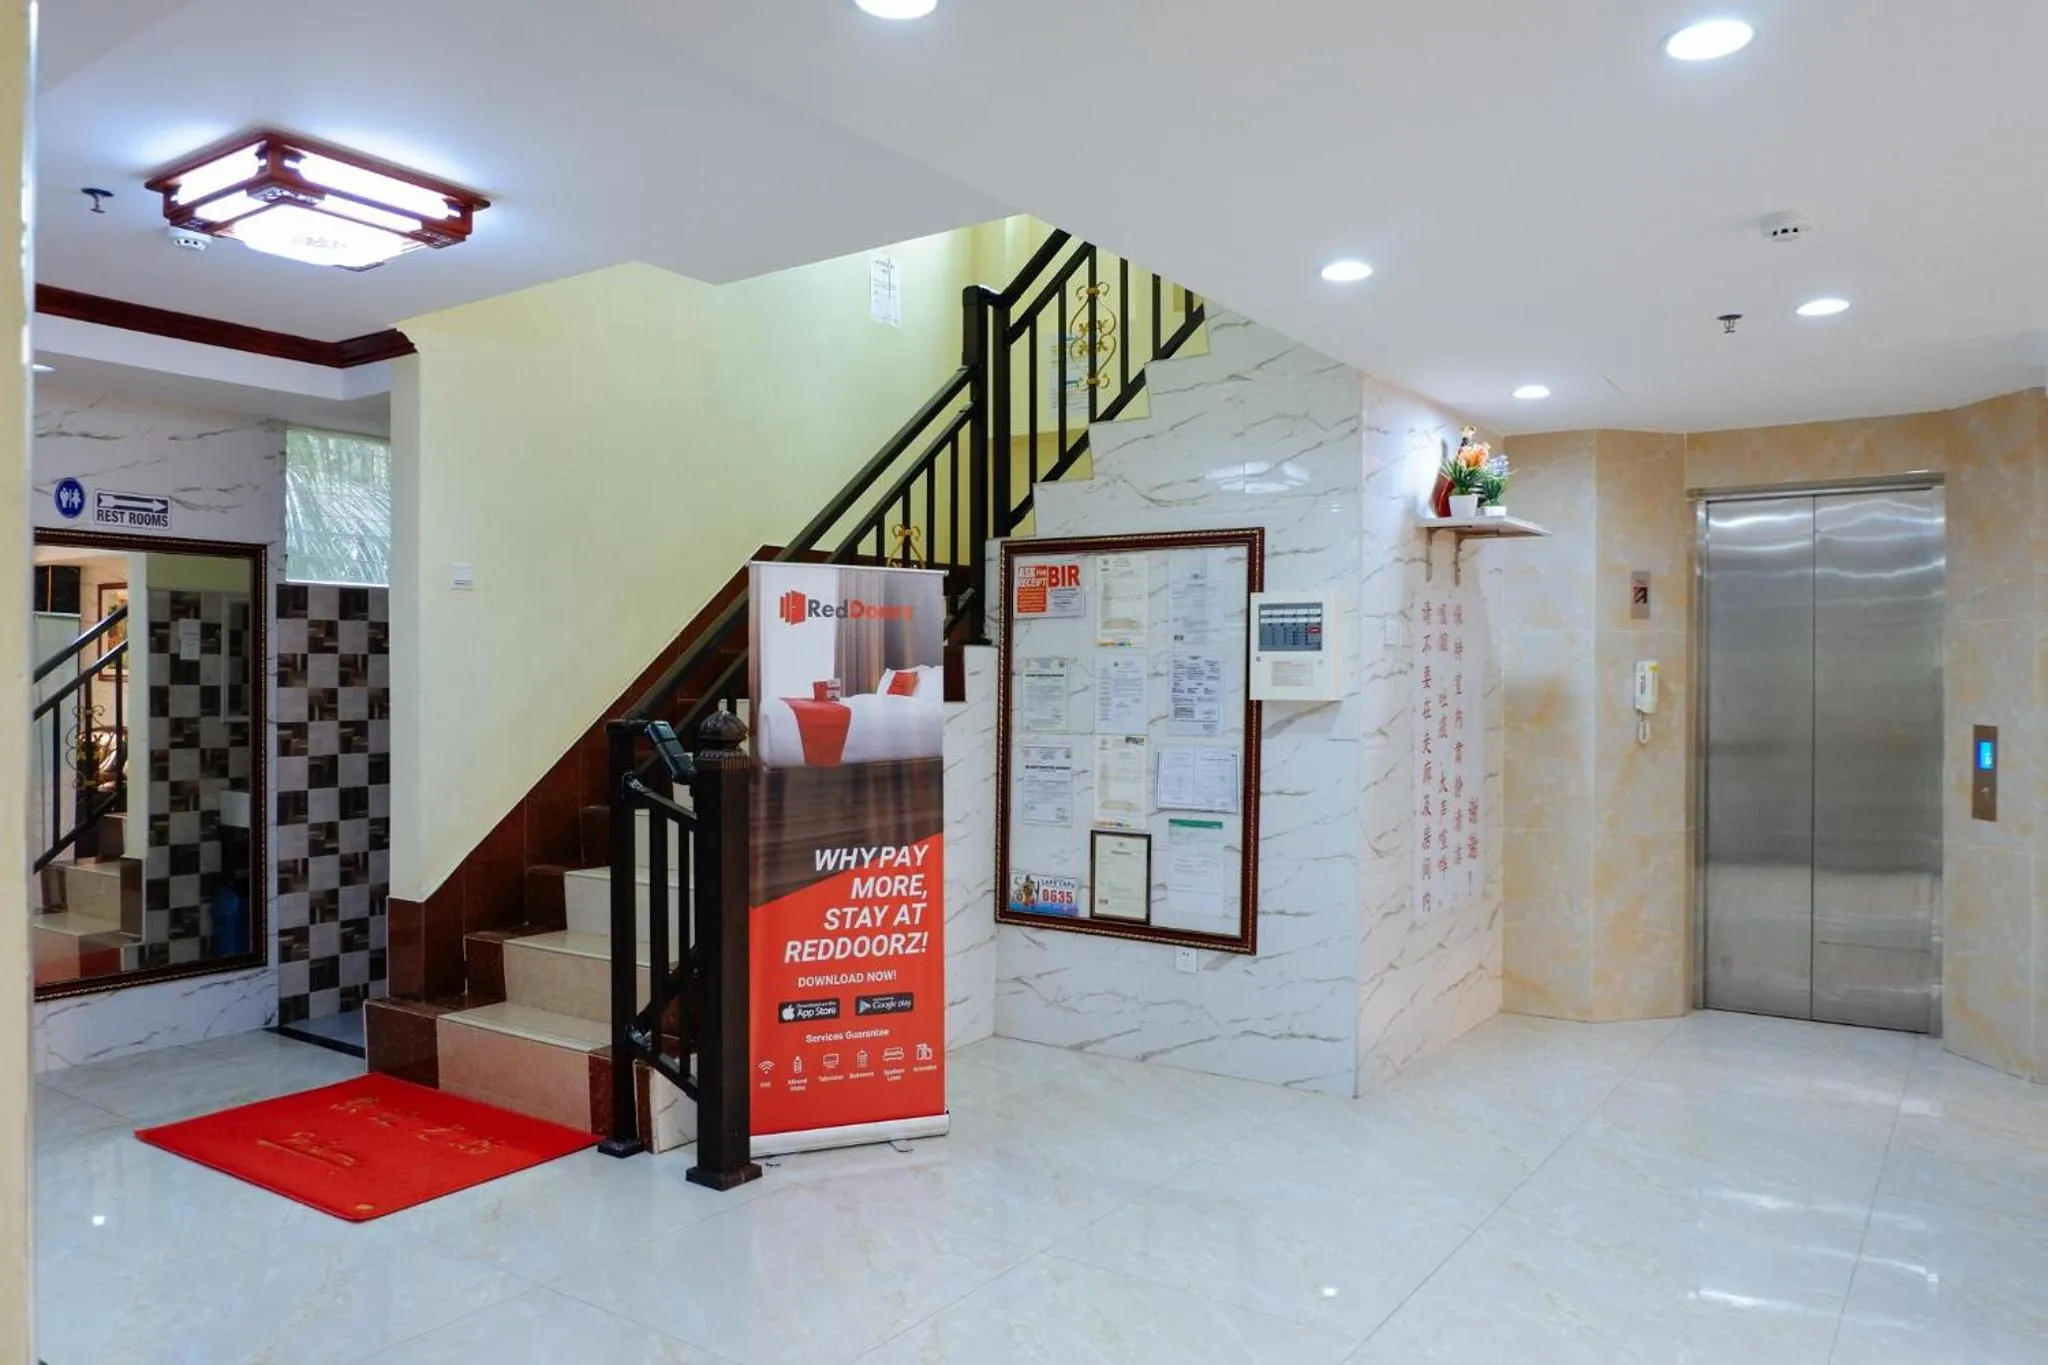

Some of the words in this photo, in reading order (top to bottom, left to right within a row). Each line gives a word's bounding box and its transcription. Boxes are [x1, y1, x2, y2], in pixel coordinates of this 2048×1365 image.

[97, 509, 125, 523] REST
[129, 512, 168, 527] ROOMS
[1048, 565, 1080, 587] BIR
[815, 846, 877, 871] WHY
[879, 844, 929, 868] PAY
[851, 874, 928, 900] MORE,
[824, 905, 889, 930] STAY
[893, 903, 928, 926] AT
[784, 931, 929, 963] REDDOORZ!
[798, 972, 864, 988] DOWNLOAD
[867, 970, 897, 983] NOW!
[797, 1009, 815, 1019] App
[816, 1006, 837, 1017] Store
[806, 1032, 843, 1043] Services
[845, 1028, 890, 1040] Guarantee
